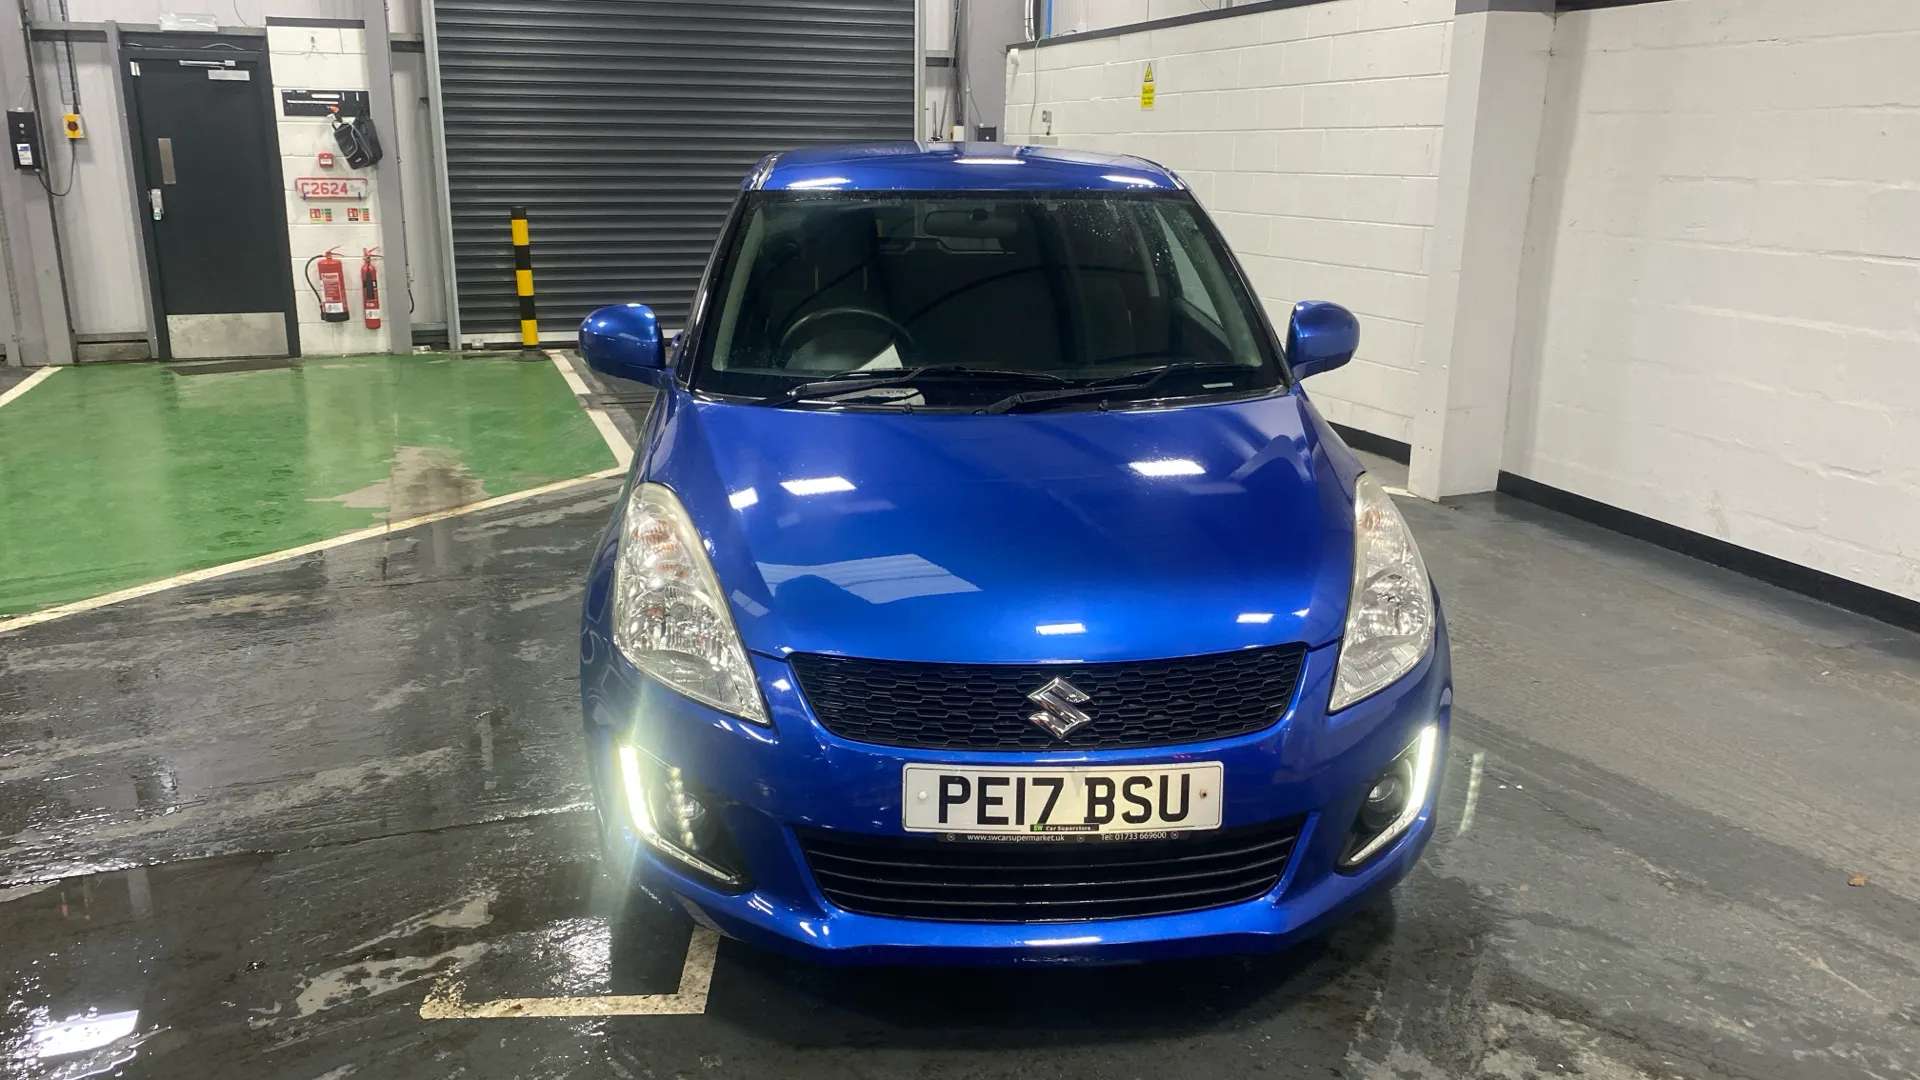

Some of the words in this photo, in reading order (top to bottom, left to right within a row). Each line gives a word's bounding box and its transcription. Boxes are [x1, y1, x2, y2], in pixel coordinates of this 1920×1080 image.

[938, 774, 1065, 825] PE17
[1083, 773, 1191, 825] BSU
[1114, 832, 1138, 841] 01733
[1139, 831, 1167, 840] 669600
